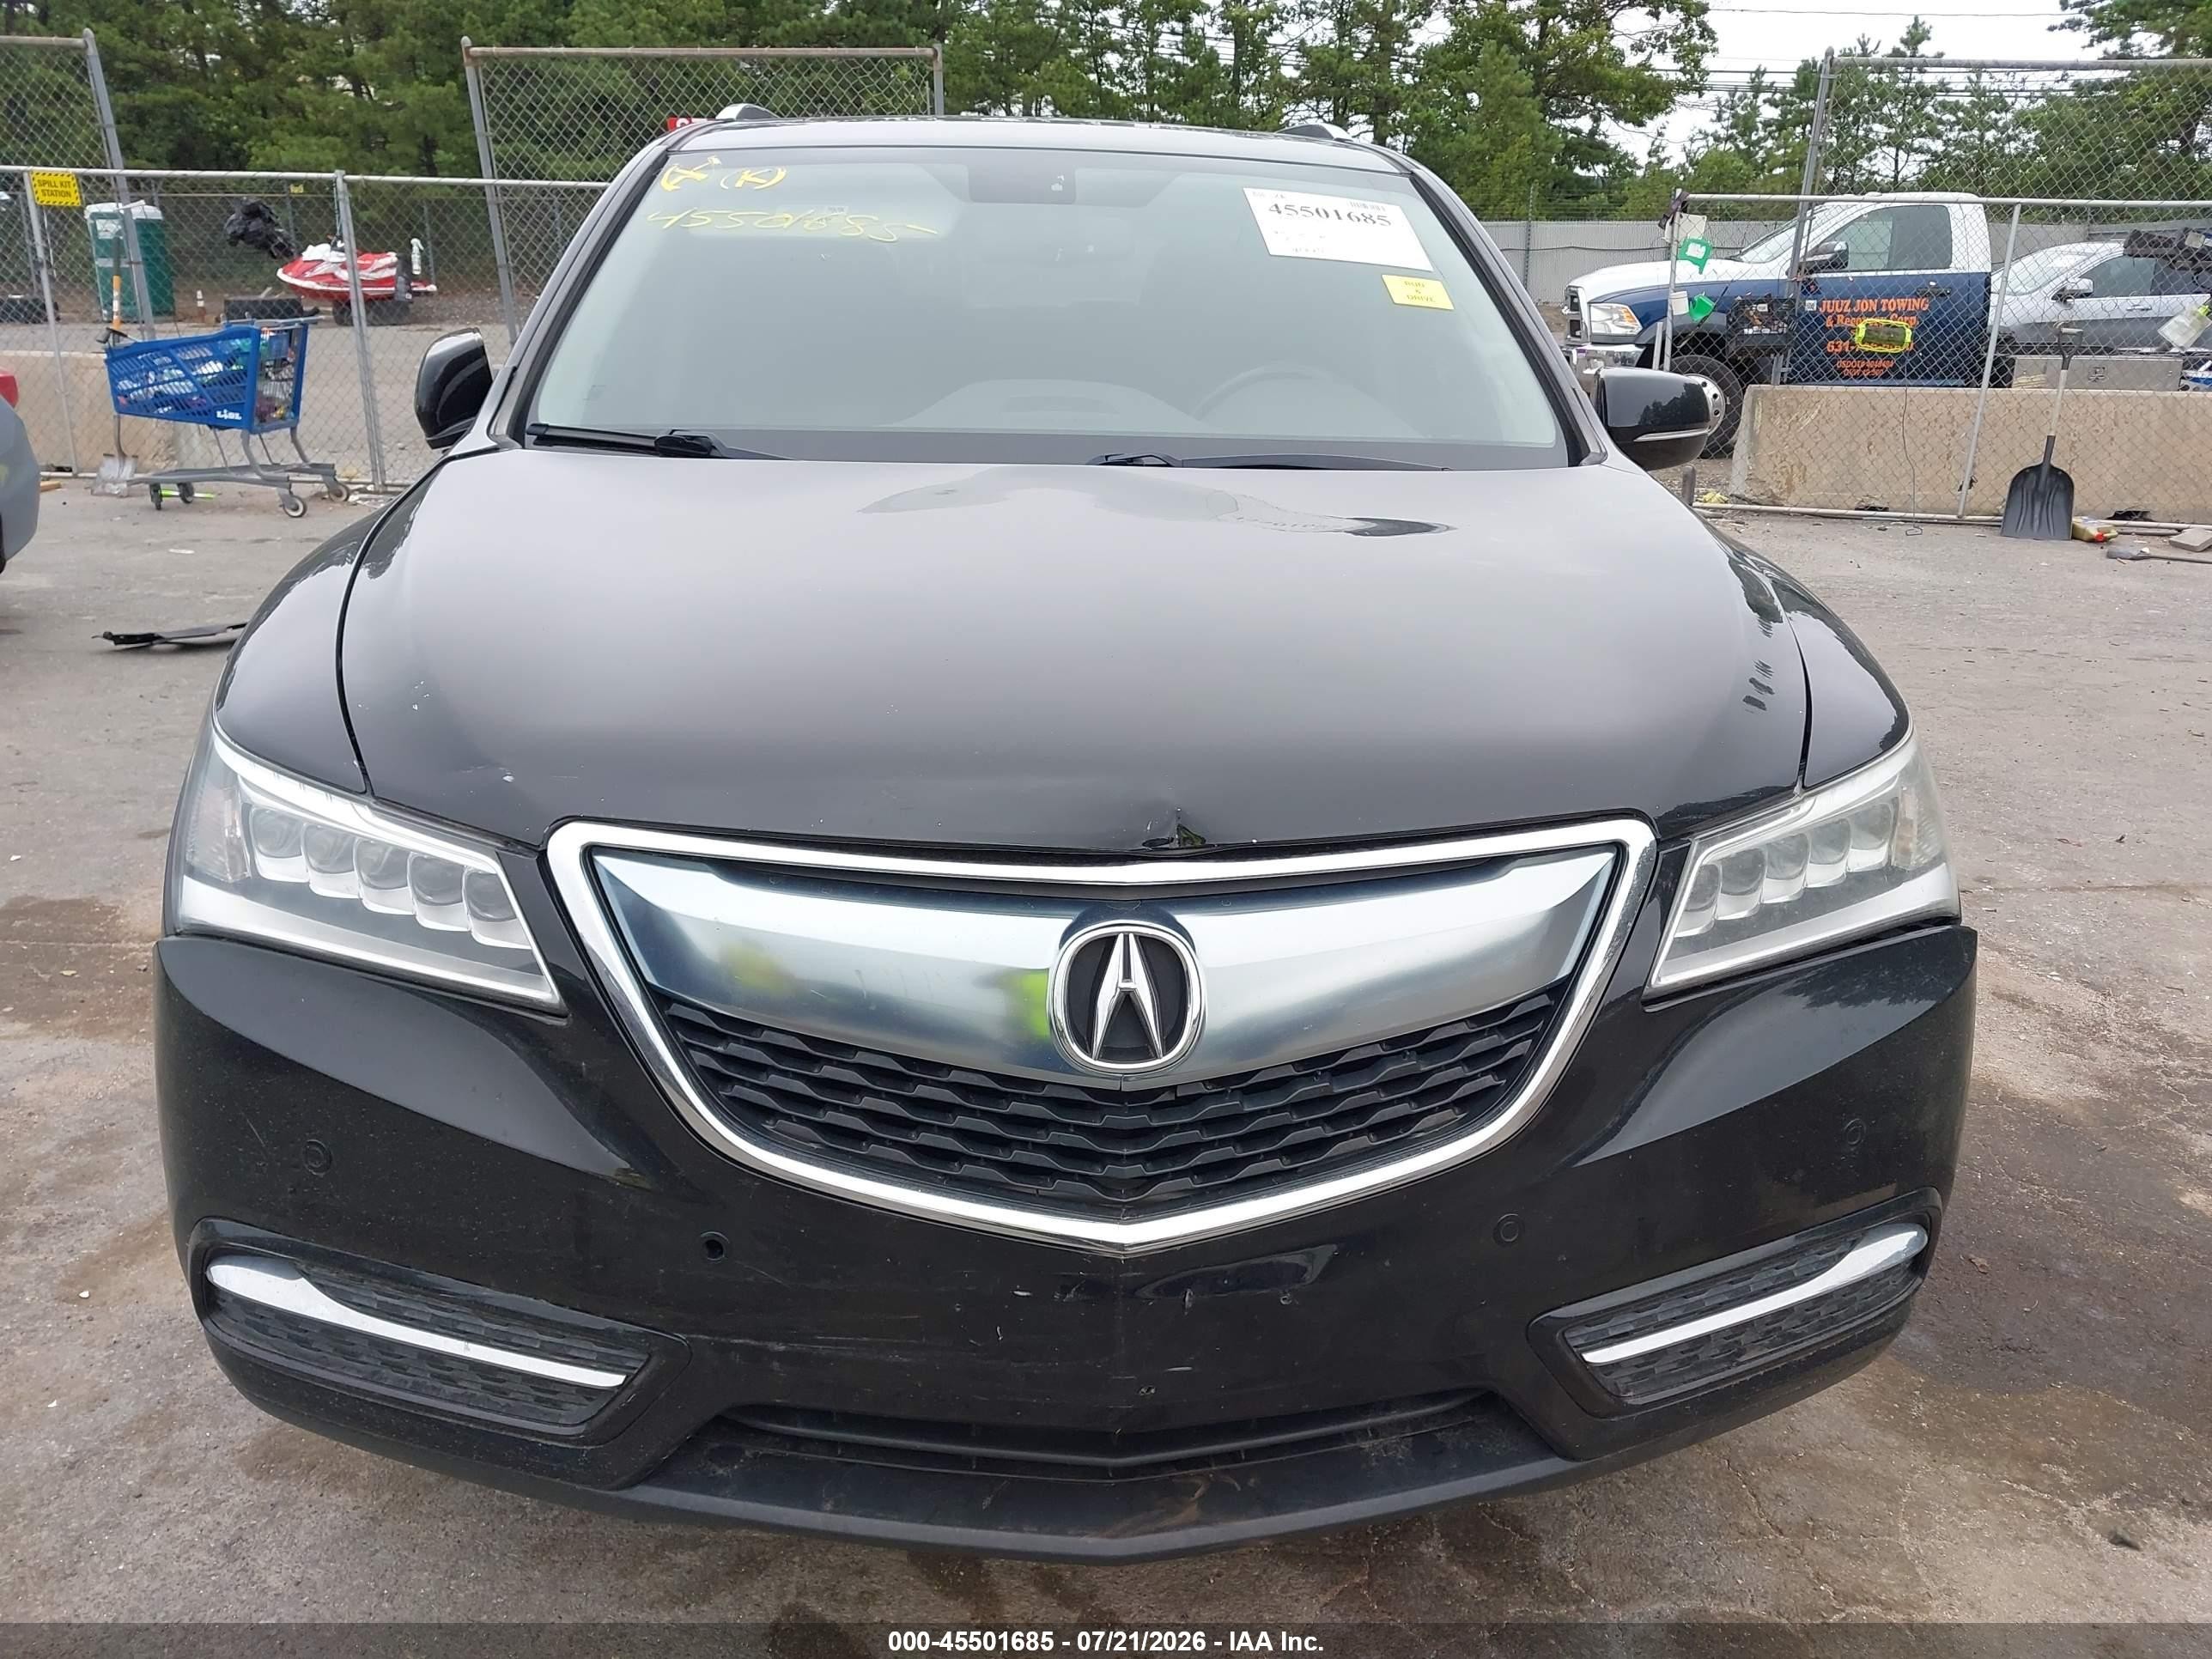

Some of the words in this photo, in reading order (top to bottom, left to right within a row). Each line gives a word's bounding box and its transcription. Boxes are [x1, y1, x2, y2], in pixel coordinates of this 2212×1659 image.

[37, 179, 58, 188] SPILL
[40, 189, 71, 198] STATION
[1268, 203, 1392, 227] 45501685
[1819, 300, 1851, 313] JUUZ
[1853, 299, 1878, 313] JON
[1881, 297, 1929, 312] TOWING
[1826, 315, 1834, 327] &
